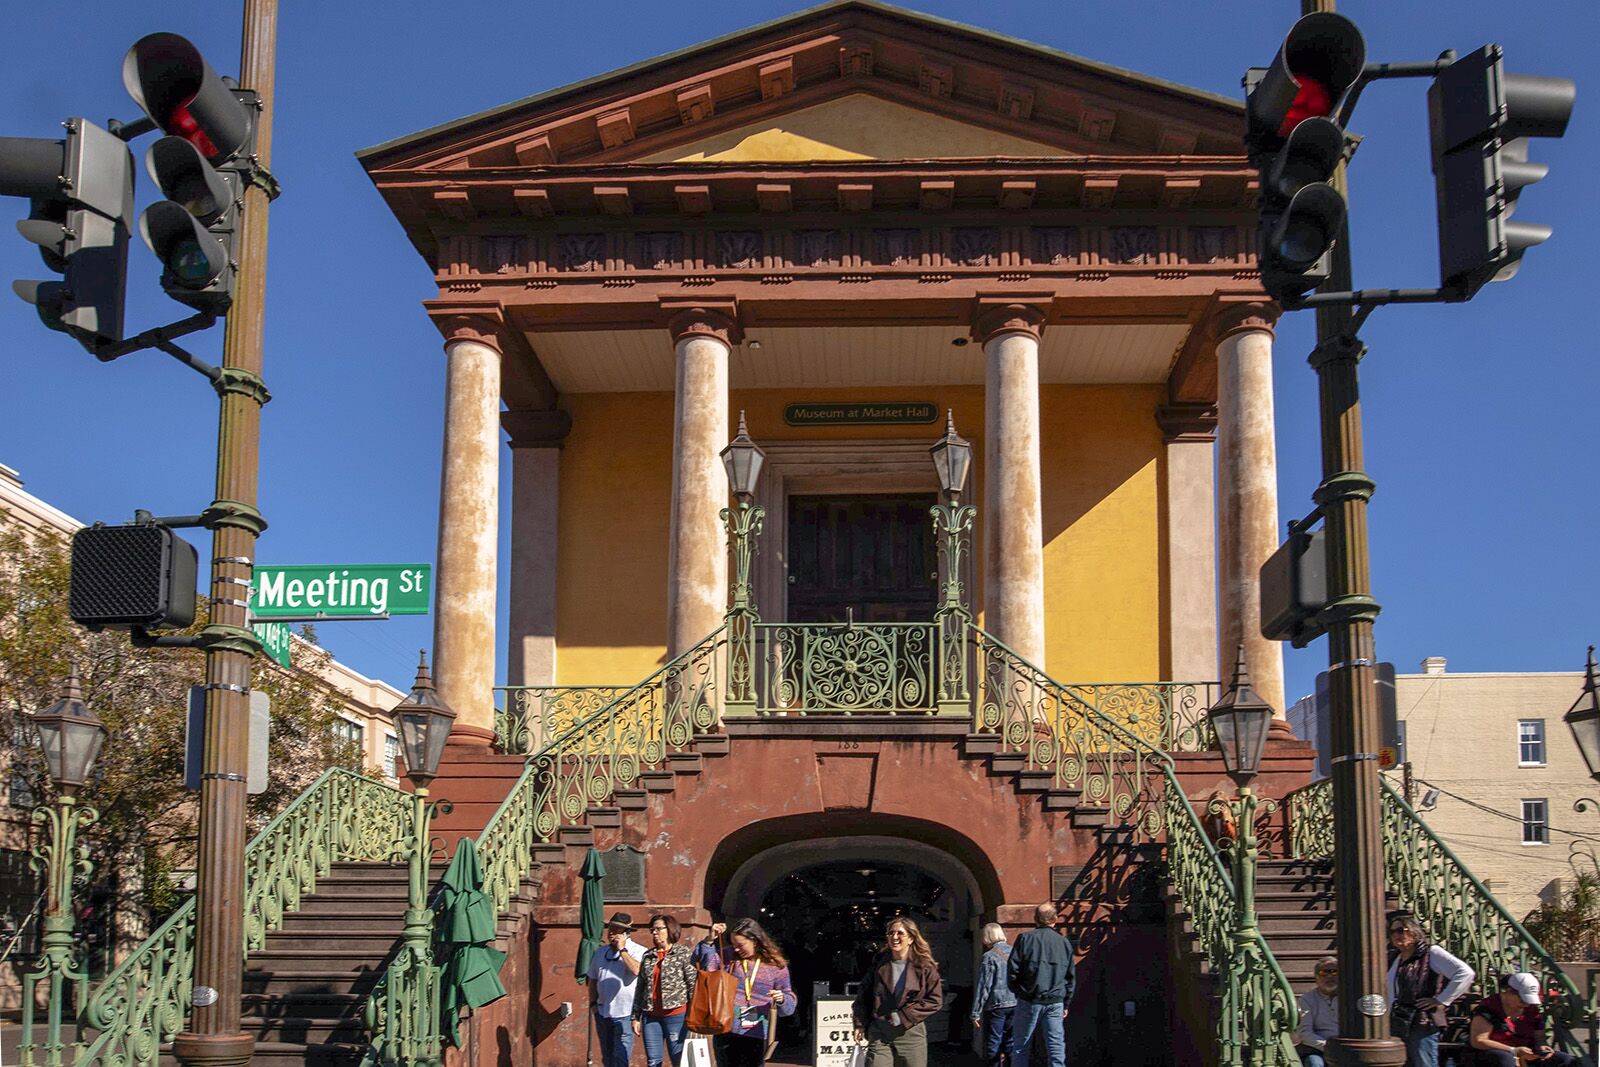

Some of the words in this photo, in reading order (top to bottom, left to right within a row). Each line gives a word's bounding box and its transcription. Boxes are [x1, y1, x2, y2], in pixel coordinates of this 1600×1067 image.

[794, 408, 844, 418] Museum
[848, 408, 858, 417] at
[862, 407, 902, 417] Market
[906, 407, 929, 417] Hall
[258, 570, 389, 614] Meeting
[399, 569, 424, 593] St
